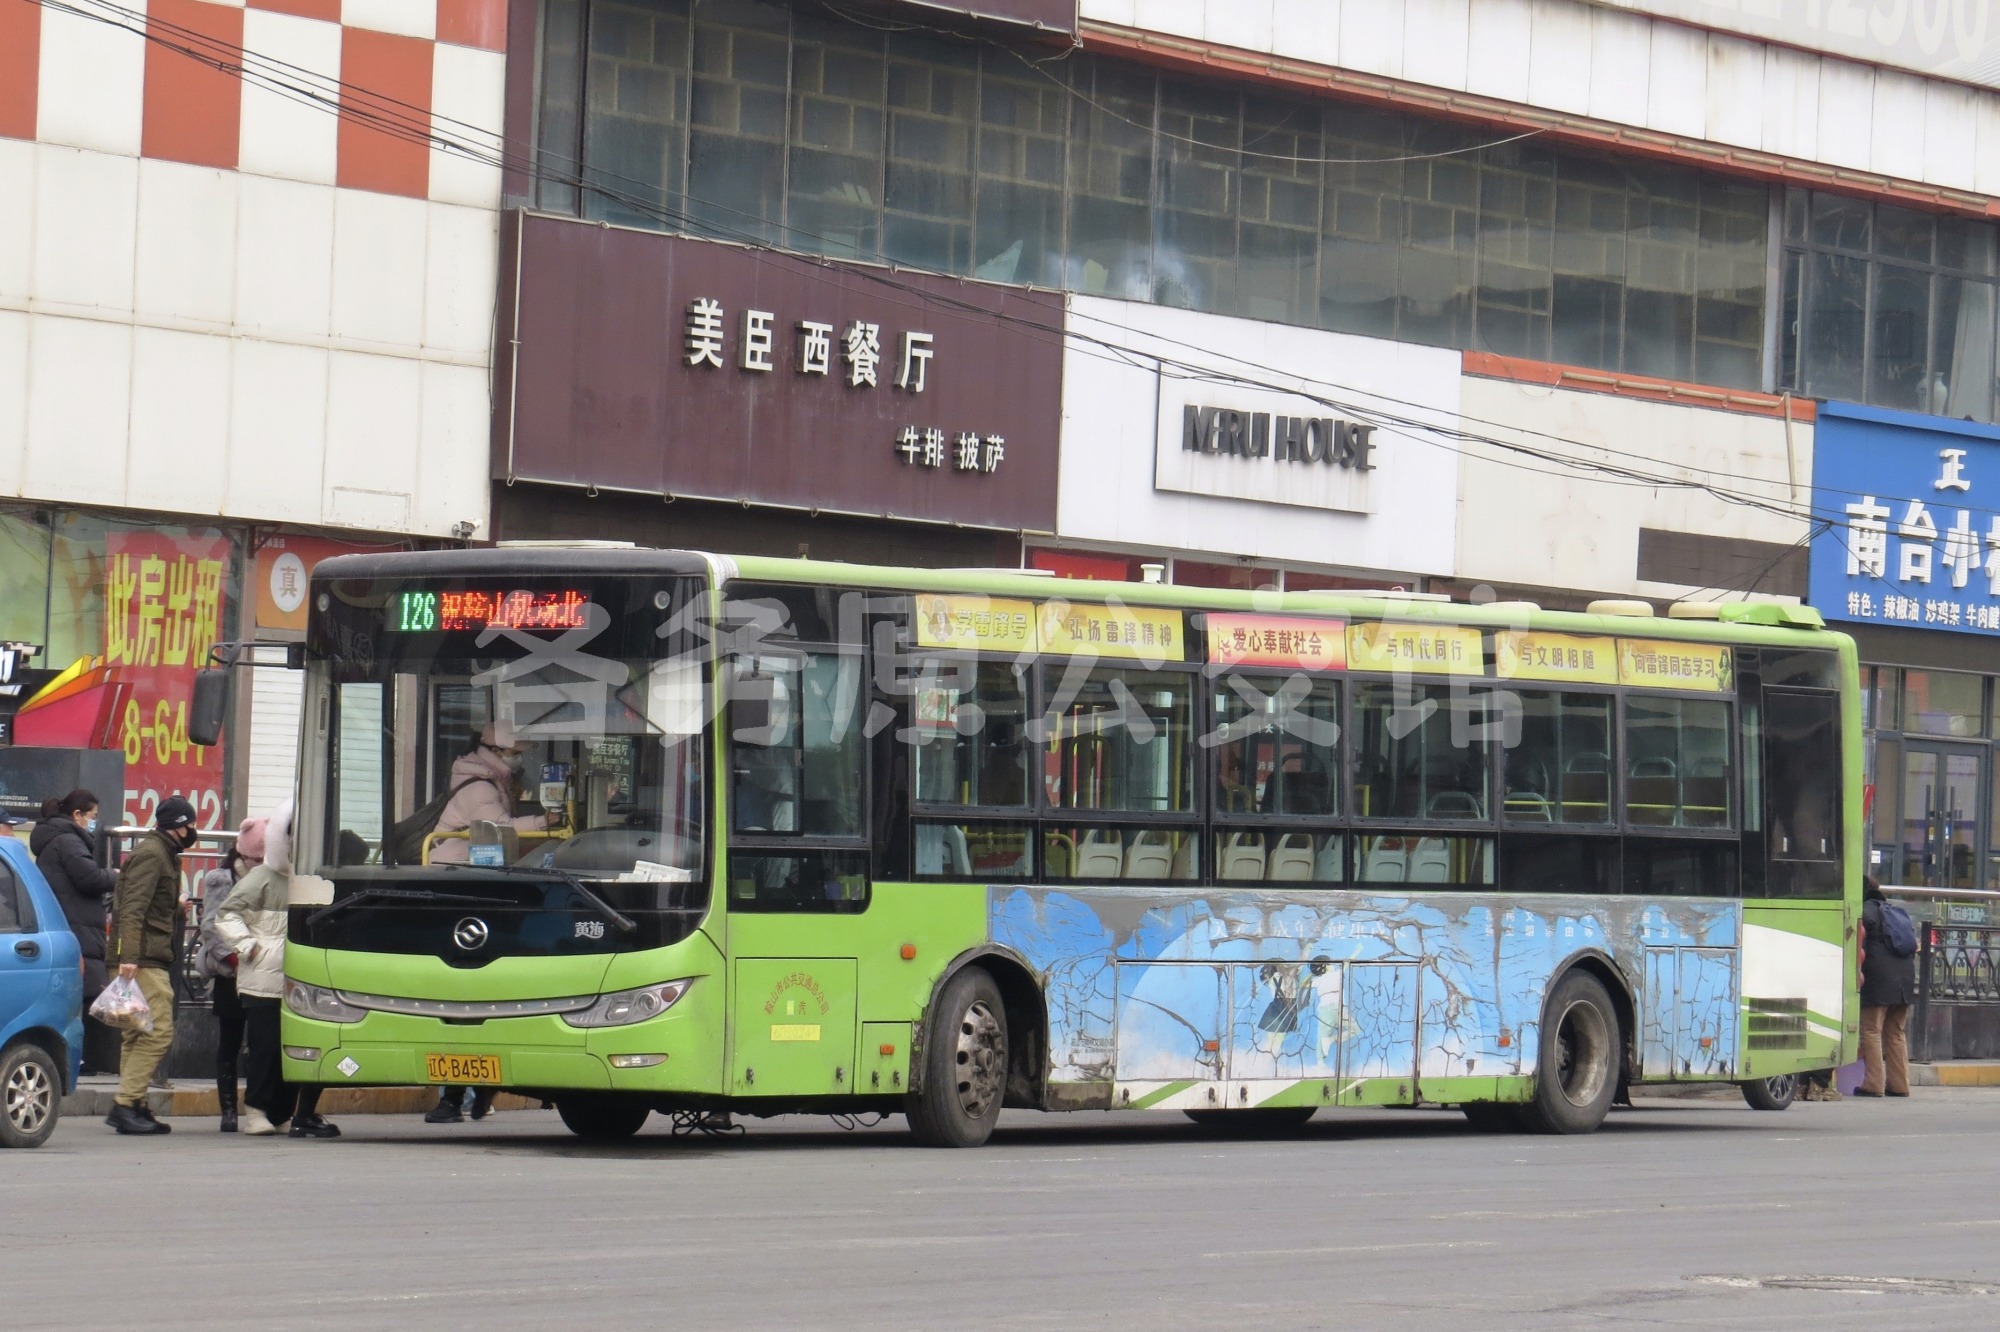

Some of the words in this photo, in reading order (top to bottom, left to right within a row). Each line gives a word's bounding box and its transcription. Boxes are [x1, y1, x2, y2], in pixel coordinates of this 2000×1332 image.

[684, 297, 934, 393] 美臣西餐厅
[897, 425, 945, 467] 牛排
[954, 431, 1005, 473] 披萨
[1275, 415, 1378, 471] HOUSE
[1934, 448, 1971, 491] 正
[280, 566, 298, 598] 真
[106, 553, 224, 669] 此房出租
[401, 592, 436, 630] 126
[955, 609, 1028, 640] 学雷锋号
[1884, 595, 1920, 621] 辣椒油
[1925, 599, 1960, 626] 炒鸡架
[1069, 617, 1173, 647] 弘扬雷锋精神
[1232, 626, 1323, 656] 爱心奉献社会
[1386, 637, 1464, 662] 与时代同行
[1520, 643, 1596, 671] 与文明相随
[1634, 652, 1717, 679] 向雷锋同志学习
[574, 921, 605, 939] 黄海
